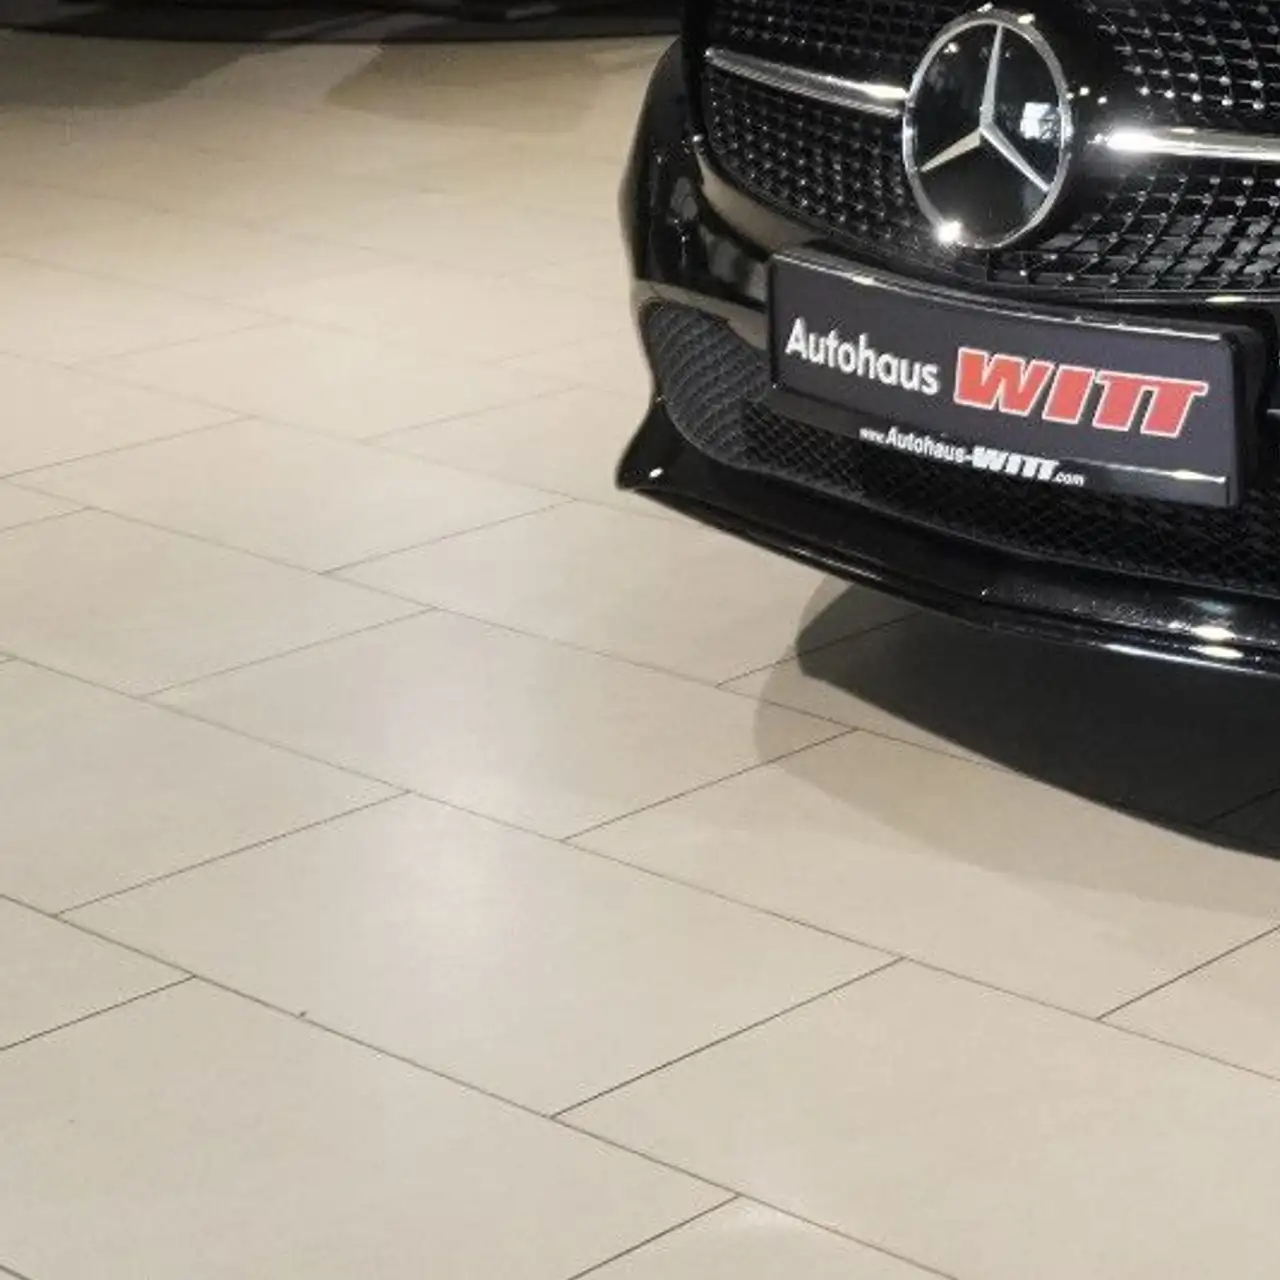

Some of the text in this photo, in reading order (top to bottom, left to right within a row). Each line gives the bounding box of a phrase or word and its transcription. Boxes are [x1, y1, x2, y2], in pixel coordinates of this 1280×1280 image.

[784, 316, 1209, 438] Autohaus WITT
[859, 425, 1085, 487] www.Autohaus-WITT.com
